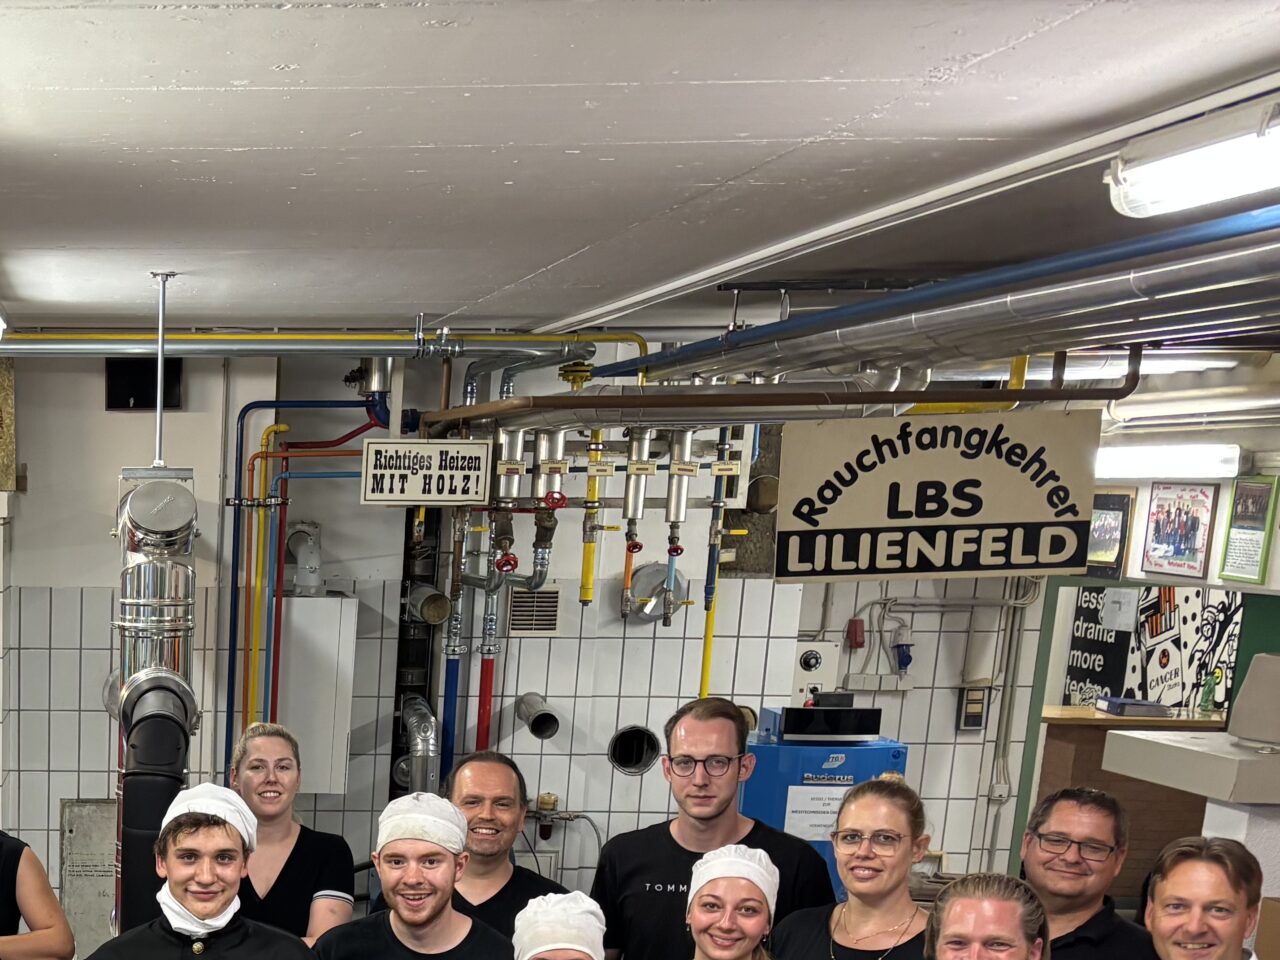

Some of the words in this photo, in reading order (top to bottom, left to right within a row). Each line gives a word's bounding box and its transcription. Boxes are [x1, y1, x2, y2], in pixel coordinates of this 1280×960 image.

[373, 449, 433, 476] Richtiges
[438, 450, 481, 472] Heizen
[792, 421, 1080, 527] Rauchfangkehrer
[371, 473, 409, 494] MIT
[421, 474, 480, 495] HOLZ!
[887, 478, 984, 520] LBS
[787, 526, 1079, 572] LILIENFELD
[1078, 586, 1105, 610] less
[1069, 650, 1104, 672] more
[645, 883, 688, 892] TOMM
